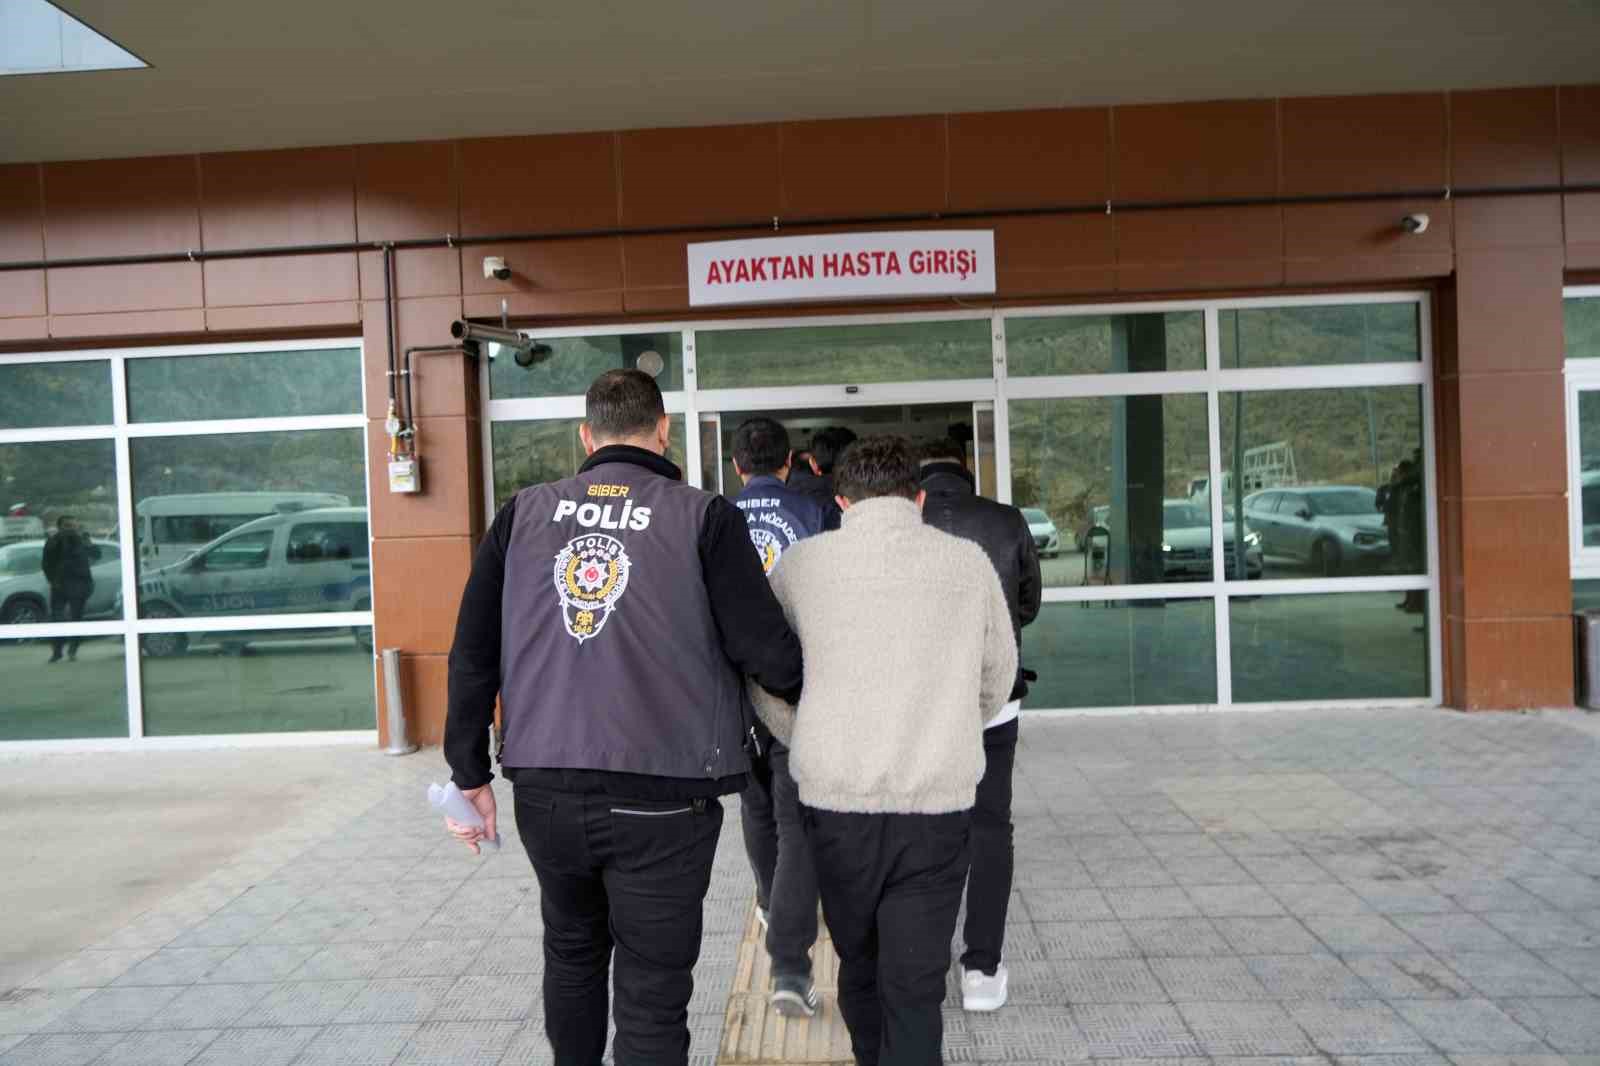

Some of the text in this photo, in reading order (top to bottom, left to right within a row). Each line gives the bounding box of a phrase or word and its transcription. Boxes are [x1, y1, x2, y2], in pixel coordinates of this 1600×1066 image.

[707, 255, 815, 285] AYAKTAN
[823, 251, 901, 277] HASTA
[552, 499, 652, 531] POLİS
